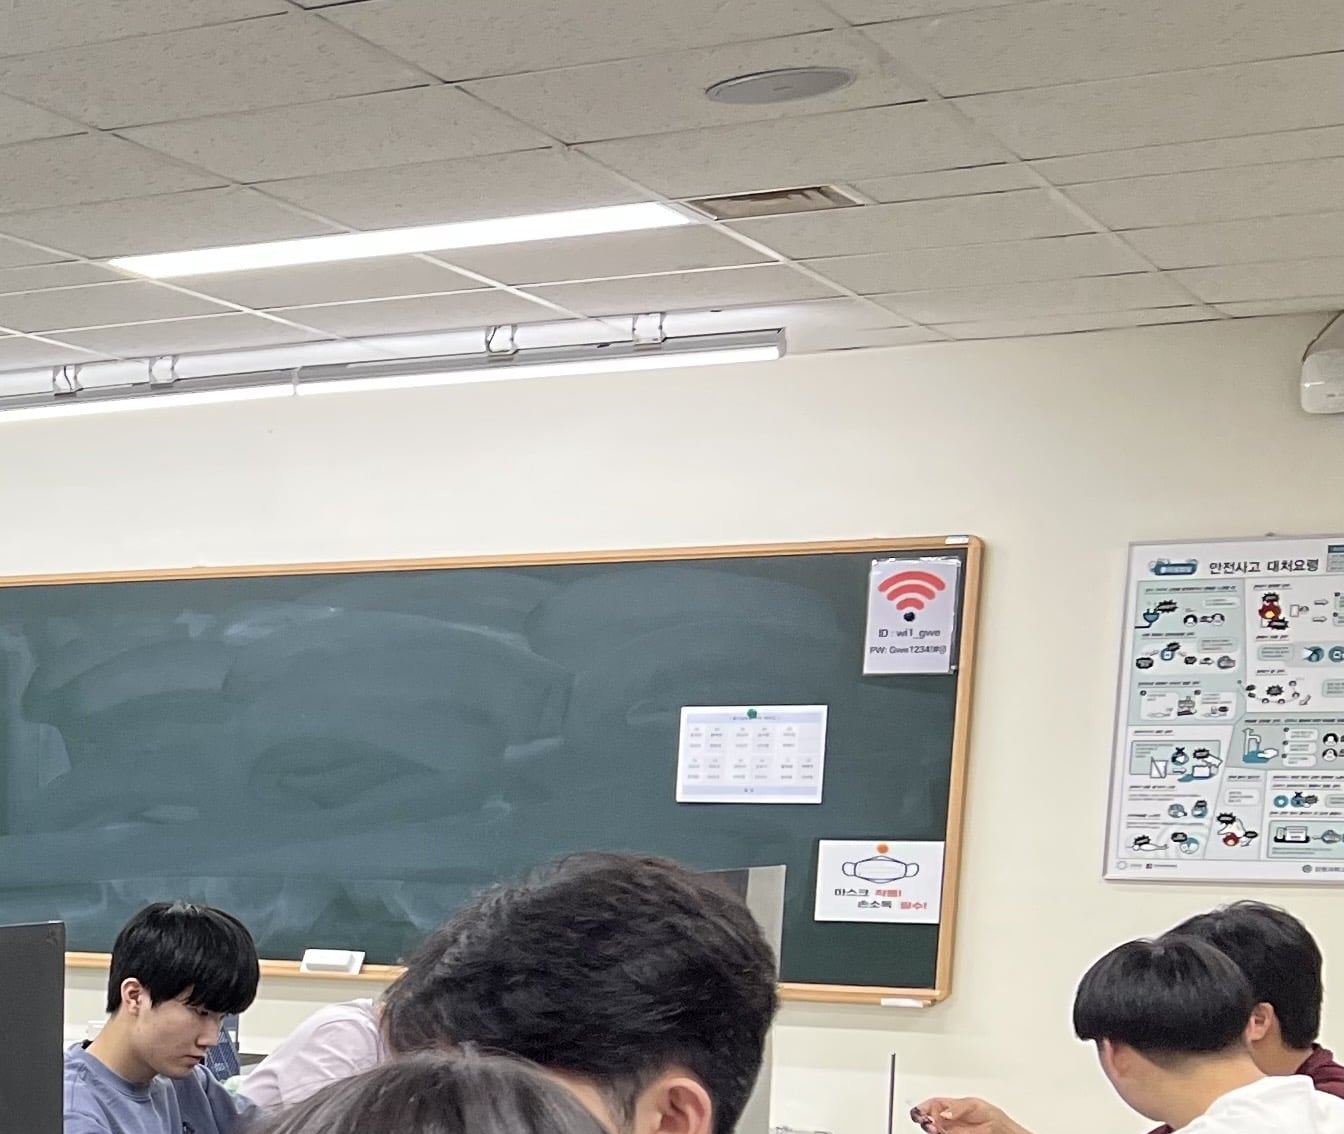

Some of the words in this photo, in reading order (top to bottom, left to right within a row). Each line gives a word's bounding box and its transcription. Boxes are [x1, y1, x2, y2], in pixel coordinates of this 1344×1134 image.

[1209, 560, 1261, 575] 안전사고
[1266, 559, 1320, 573] 대처요령
[834, 888, 869, 897] 마스크
